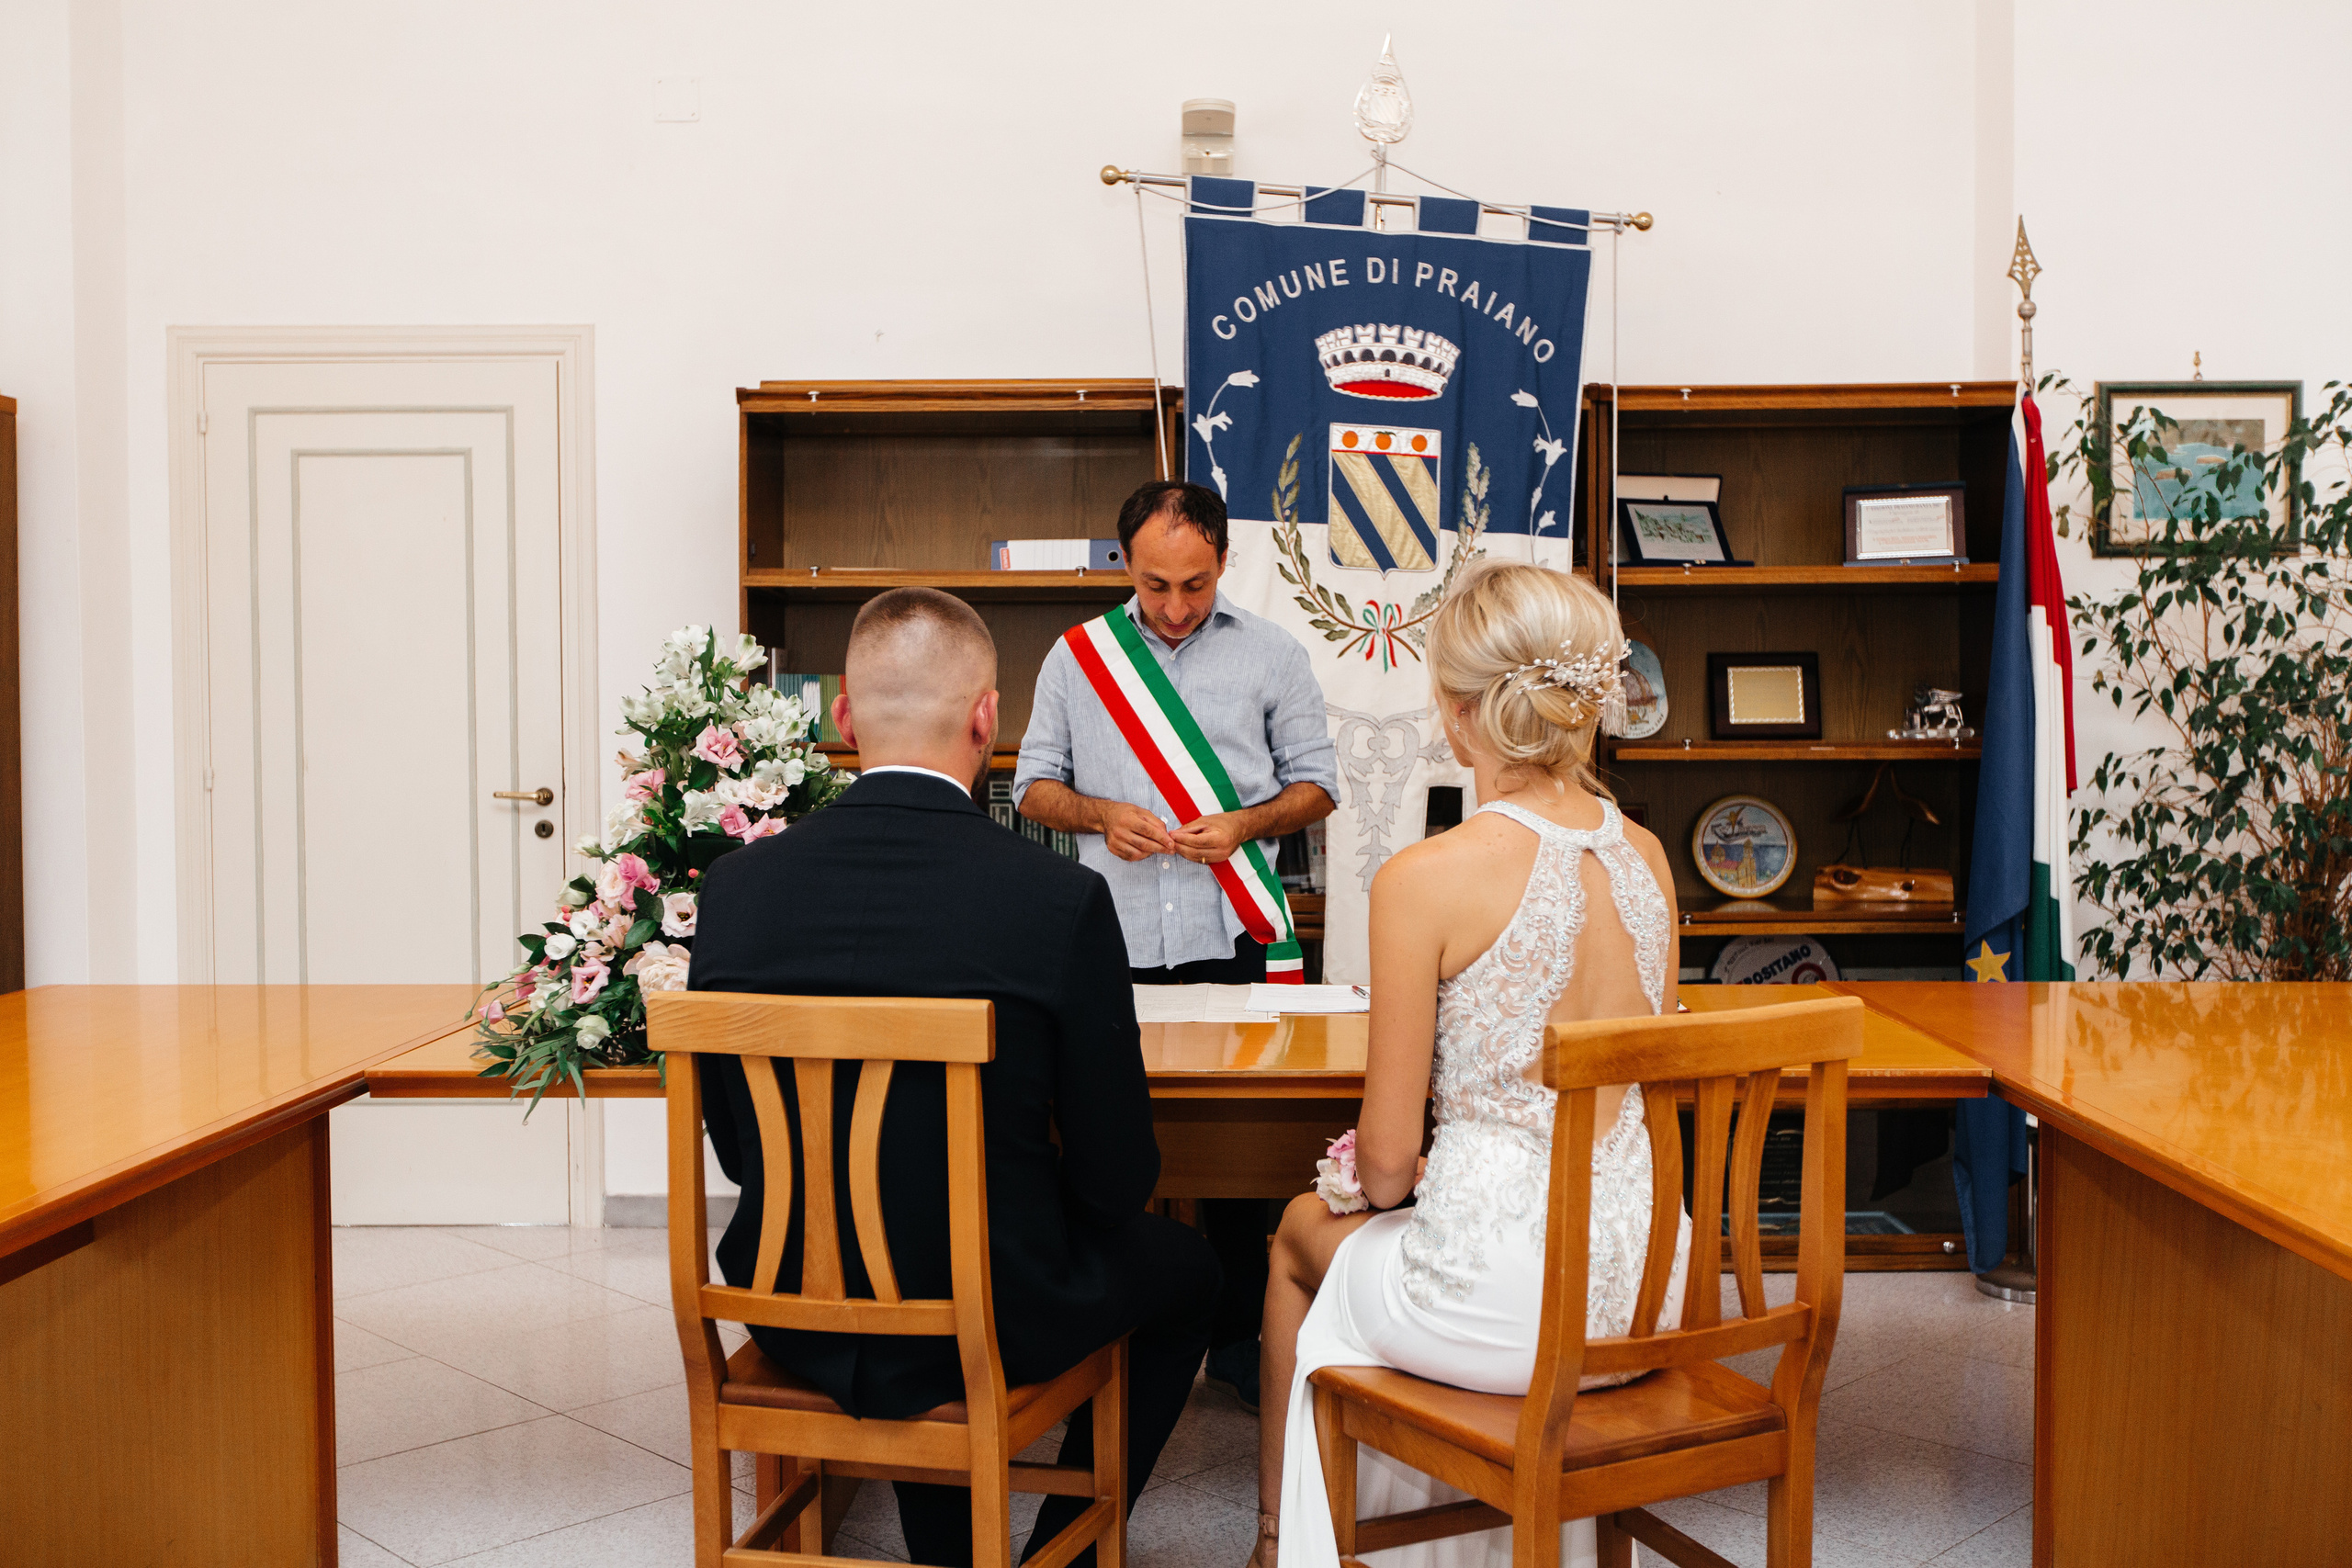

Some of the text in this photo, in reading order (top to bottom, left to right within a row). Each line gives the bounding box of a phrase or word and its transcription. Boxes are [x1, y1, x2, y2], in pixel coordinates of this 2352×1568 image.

[1211, 257, 1555, 364] COMUNE DI PRAIANO
